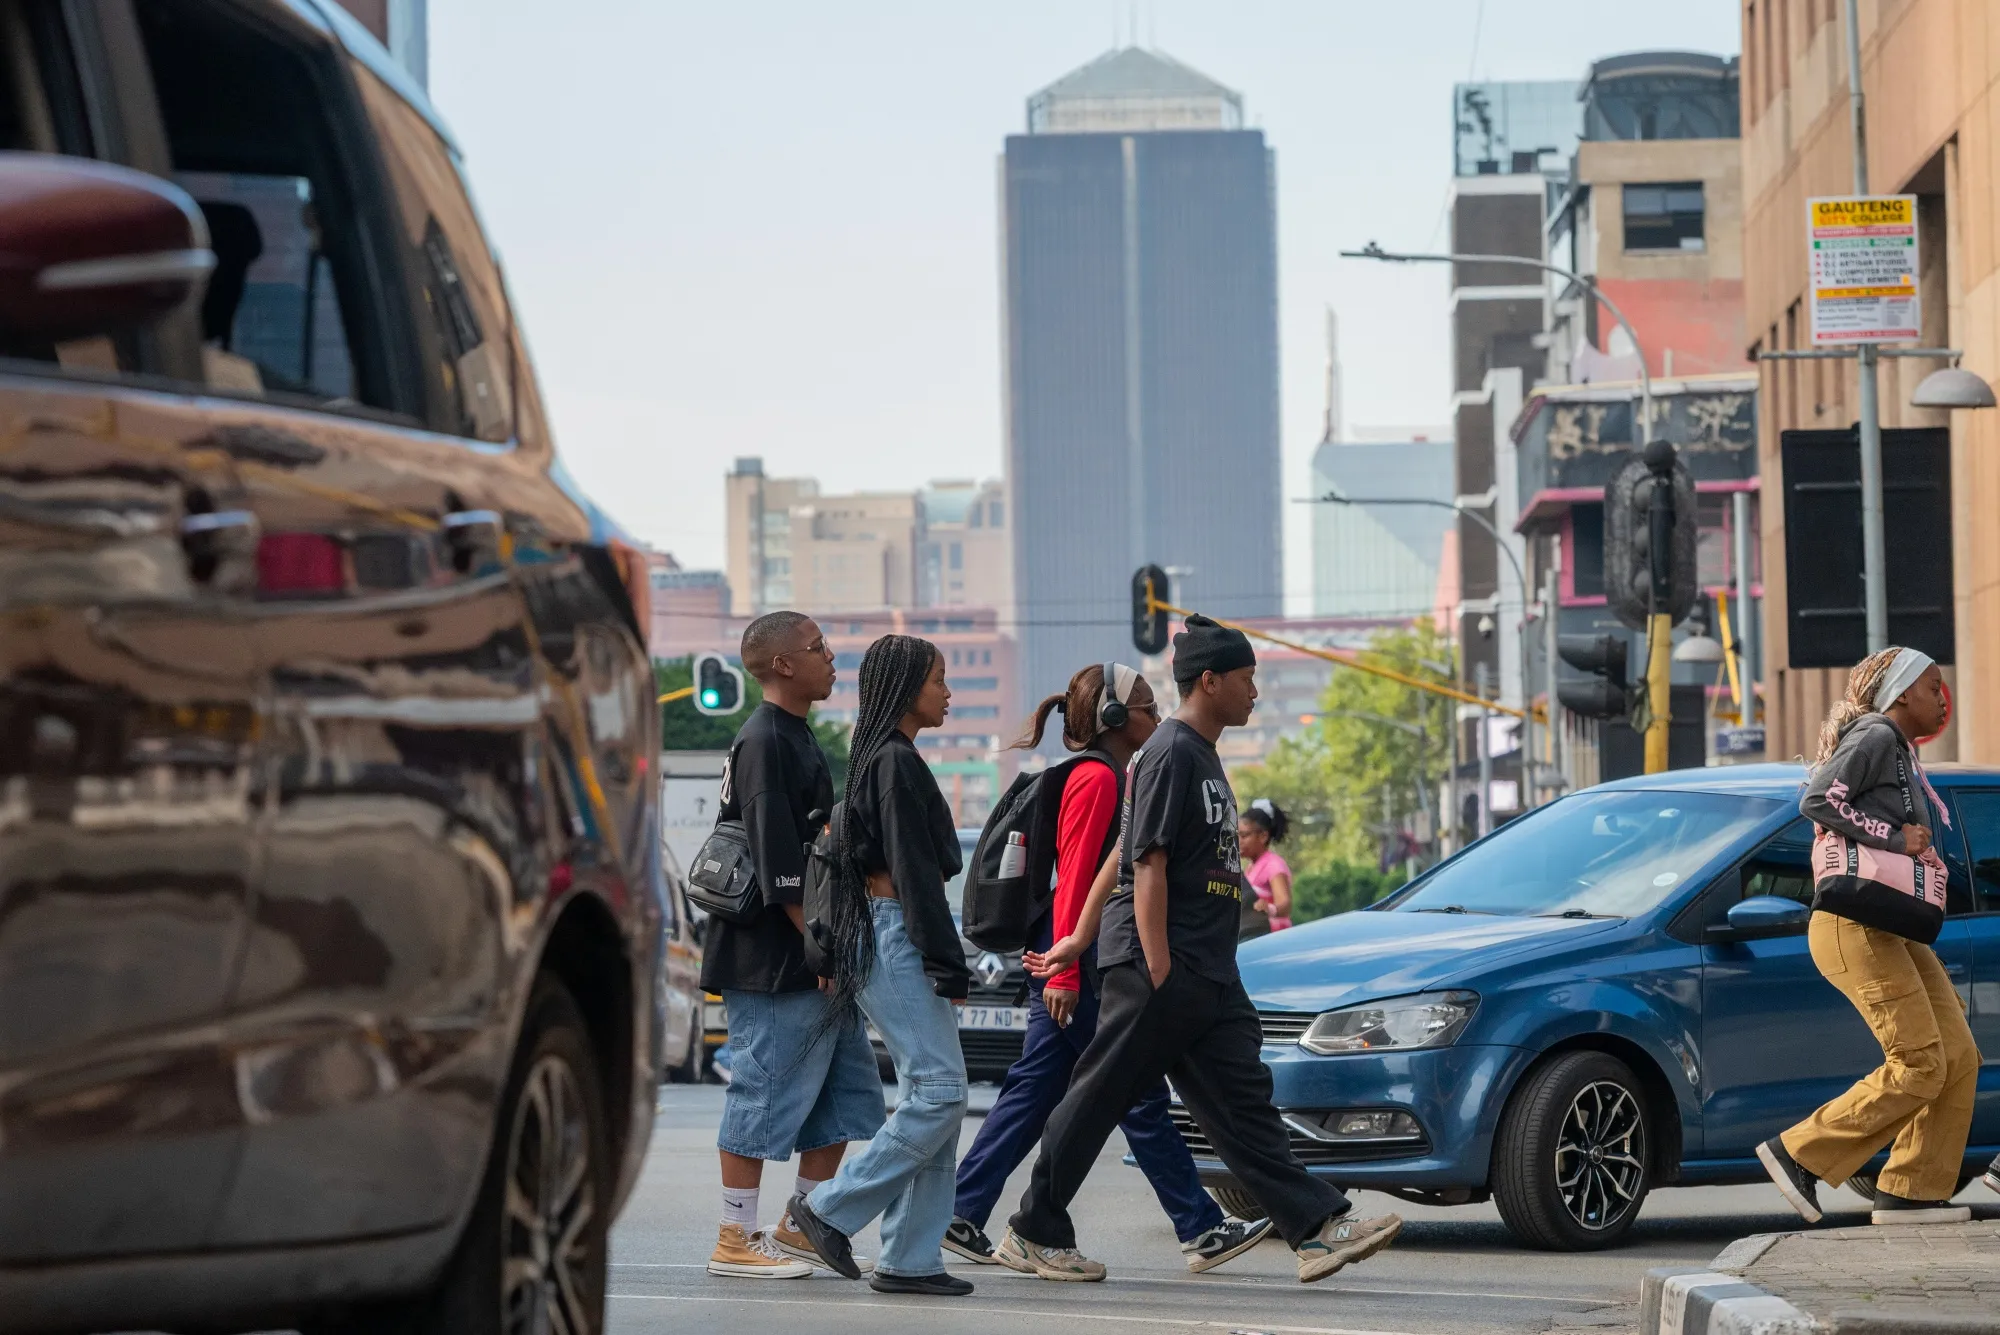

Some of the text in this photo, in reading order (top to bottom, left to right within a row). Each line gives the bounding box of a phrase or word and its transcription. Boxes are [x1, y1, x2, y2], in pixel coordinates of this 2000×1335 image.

[1819, 200, 1904, 214] GAUTENG
[1819, 214, 1903, 225] CITY COLLEGE
[1902, 787, 1914, 813] PINK
[1848, 847, 1858, 868] PINK
[1915, 864, 1924, 885] HOT
[1933, 870, 1947, 902] HOT
[971, 1009, 987, 1026] 77
[994, 1010, 1012, 1027] ND
[1336, 1225, 1351, 1239] N
